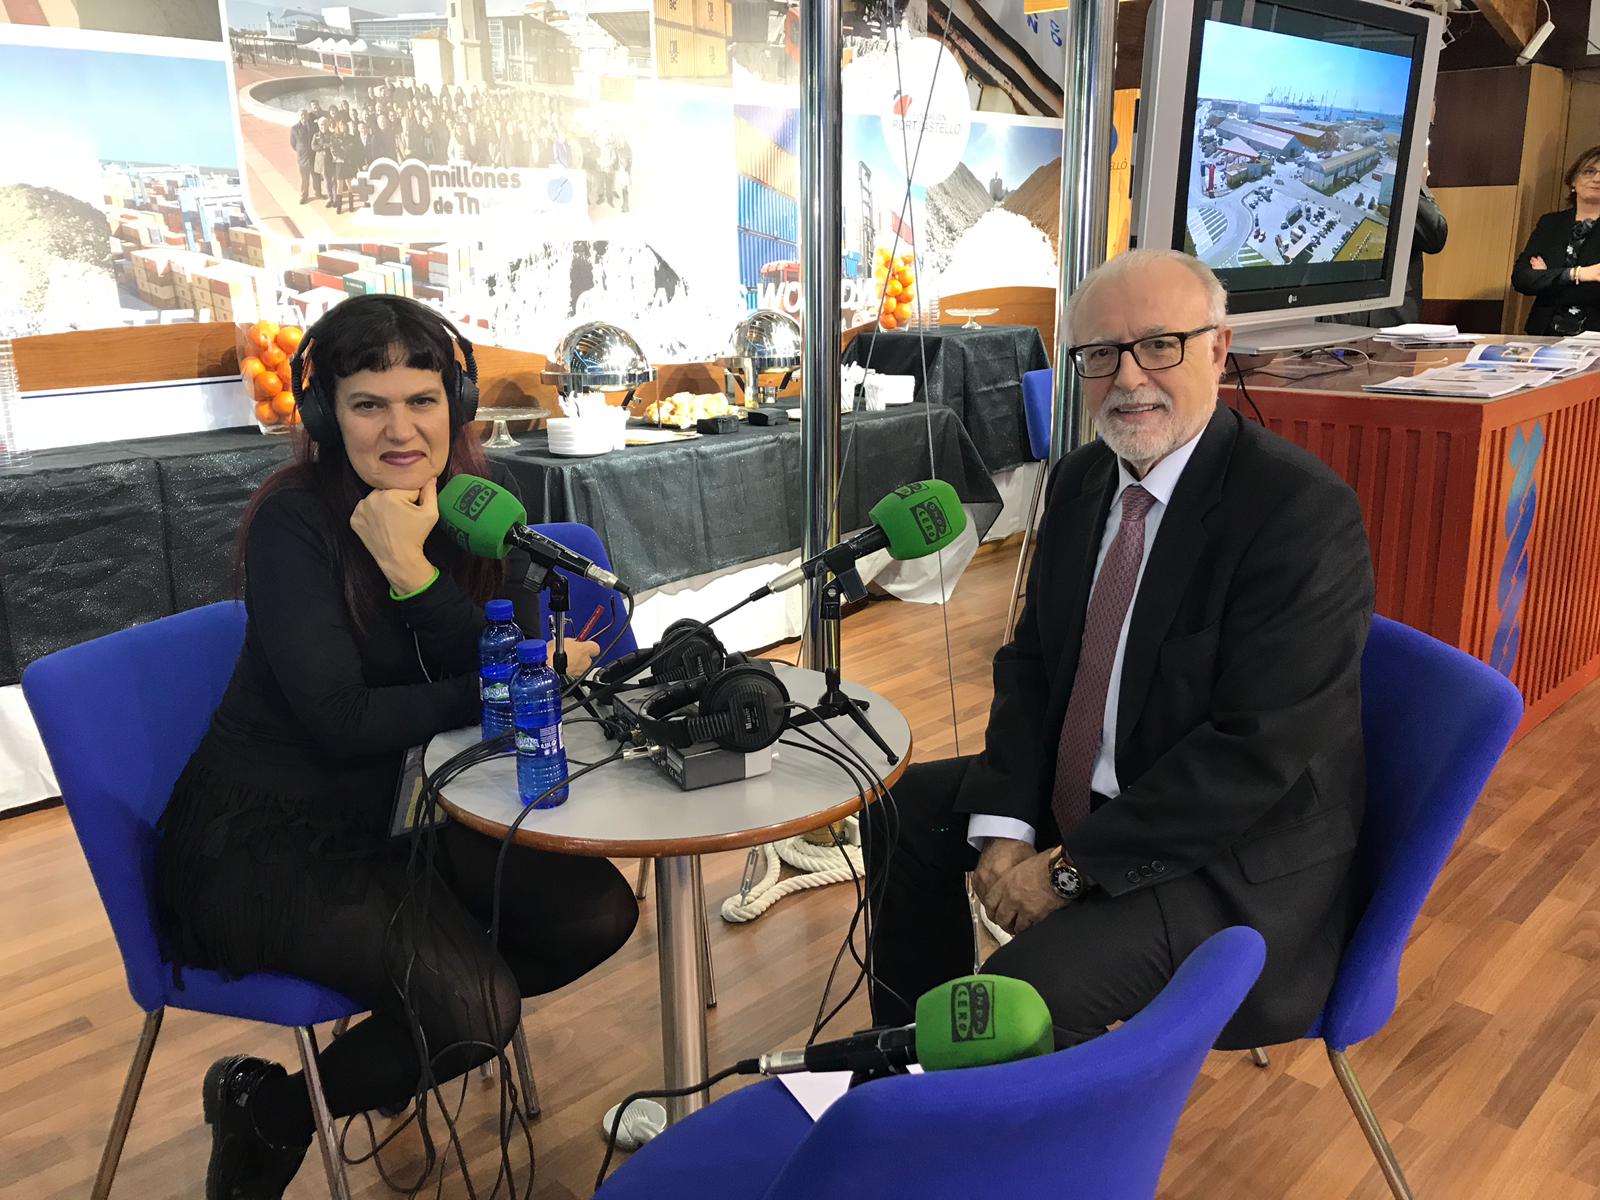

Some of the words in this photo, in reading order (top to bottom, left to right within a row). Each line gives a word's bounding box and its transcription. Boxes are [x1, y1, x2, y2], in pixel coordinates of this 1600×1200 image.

[431, 164, 521, 189] millones
[433, 196, 453, 215] de
[918, 510, 937, 538] CERO
[957, 990, 968, 1032] CERO
[975, 986, 985, 1030] ONDA
